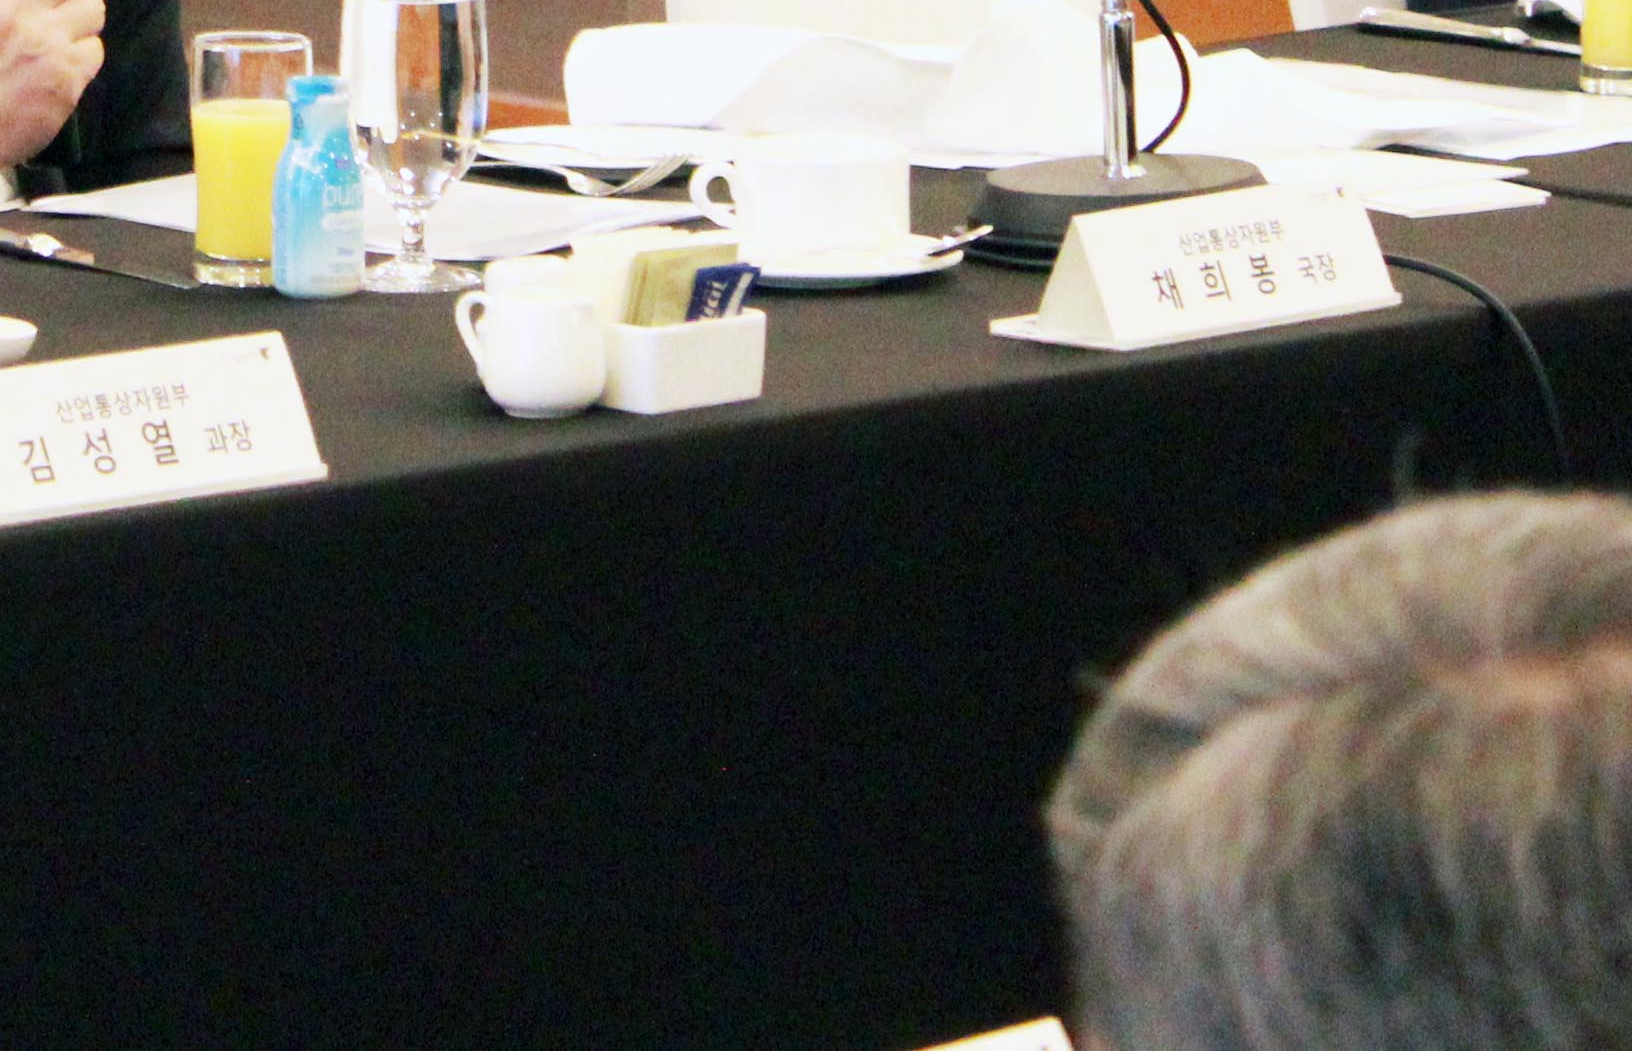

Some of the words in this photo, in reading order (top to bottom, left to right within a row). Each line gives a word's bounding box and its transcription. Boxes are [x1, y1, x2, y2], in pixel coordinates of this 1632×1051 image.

[1179, 219, 1284, 256] 산업통상자원부
[1297, 252, 1337, 283] 국장
[56, 383, 189, 424] 산업통상자원부
[203, 419, 253, 454] 과장
